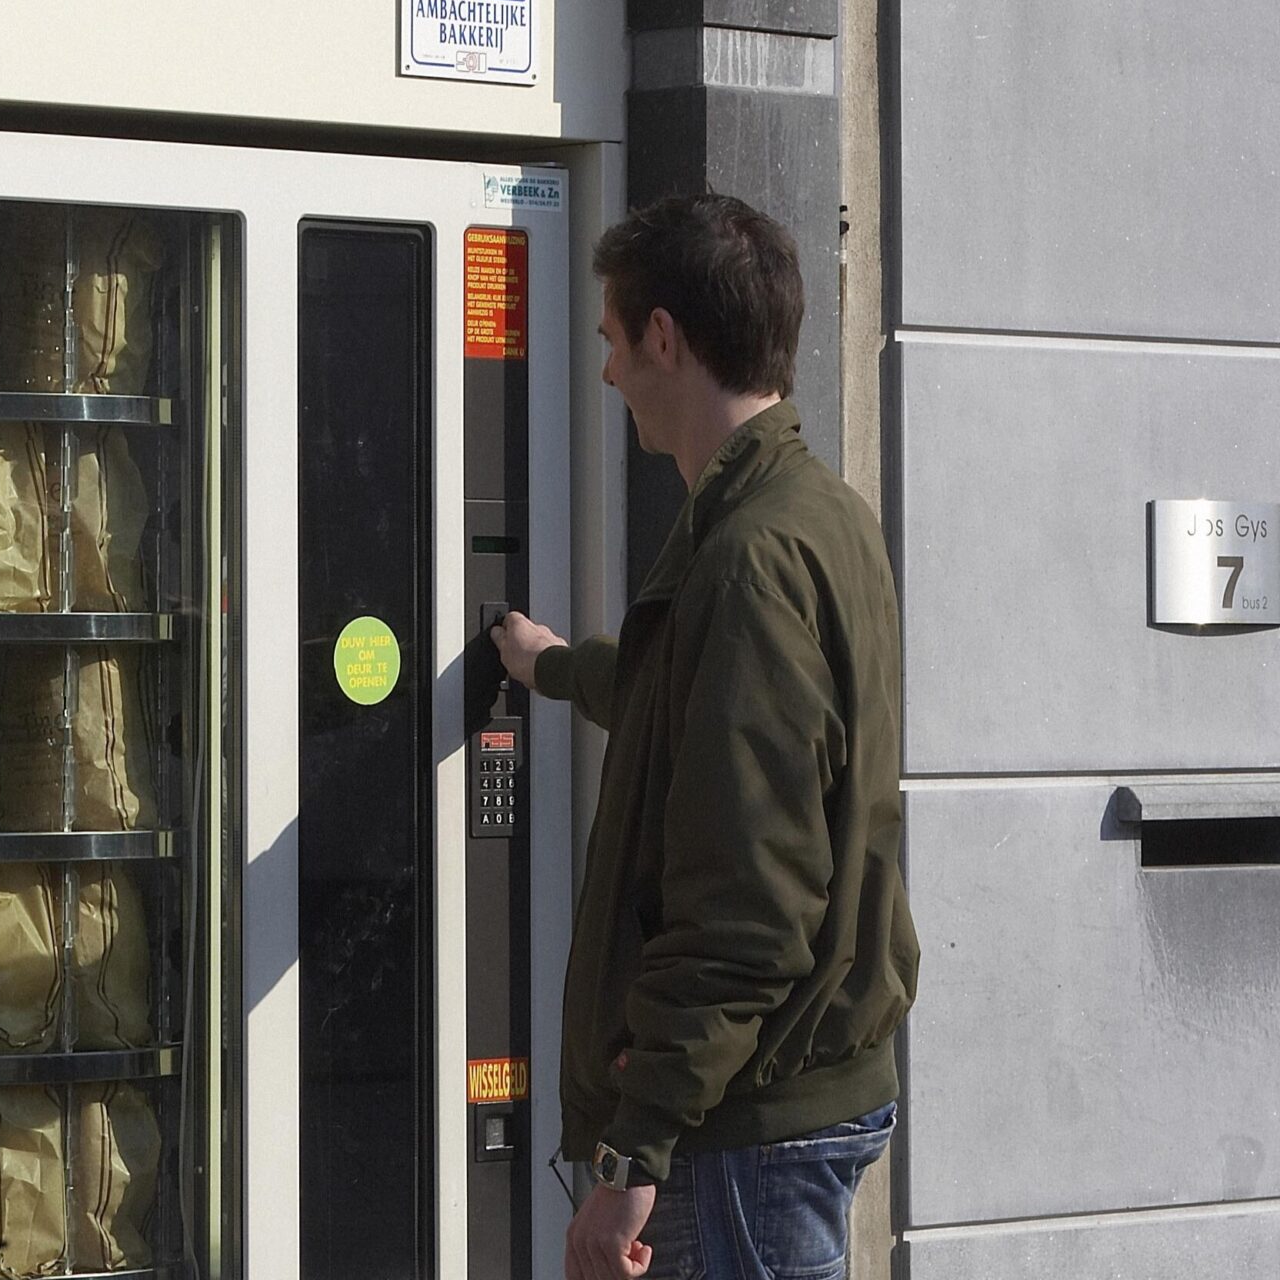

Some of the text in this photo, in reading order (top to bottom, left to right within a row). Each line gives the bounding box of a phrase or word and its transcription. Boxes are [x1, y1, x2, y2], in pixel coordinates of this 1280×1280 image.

[439, 23, 504, 54] BAKKERIJ
[500, 184, 539, 197] VERBEEK
[548, 187, 560, 199] Zn
[1235, 514, 1267, 542] Gys
[1217, 556, 1268, 610] 7 bus 2
[370, 636, 391, 646] HIER
[358, 650, 375, 660] OM
[347, 663, 387, 675] DEUR TE
[349, 676, 386, 688] OPENEN
[483, 762, 514, 771] 1 2 3
[483, 779, 514, 788] 4 5 6
[483, 796, 514, 806] 7 8 9
[483, 814, 488, 824] A
[496, 814, 501, 824] 0
[469, 1063, 526, 1098] WISSELGELD
